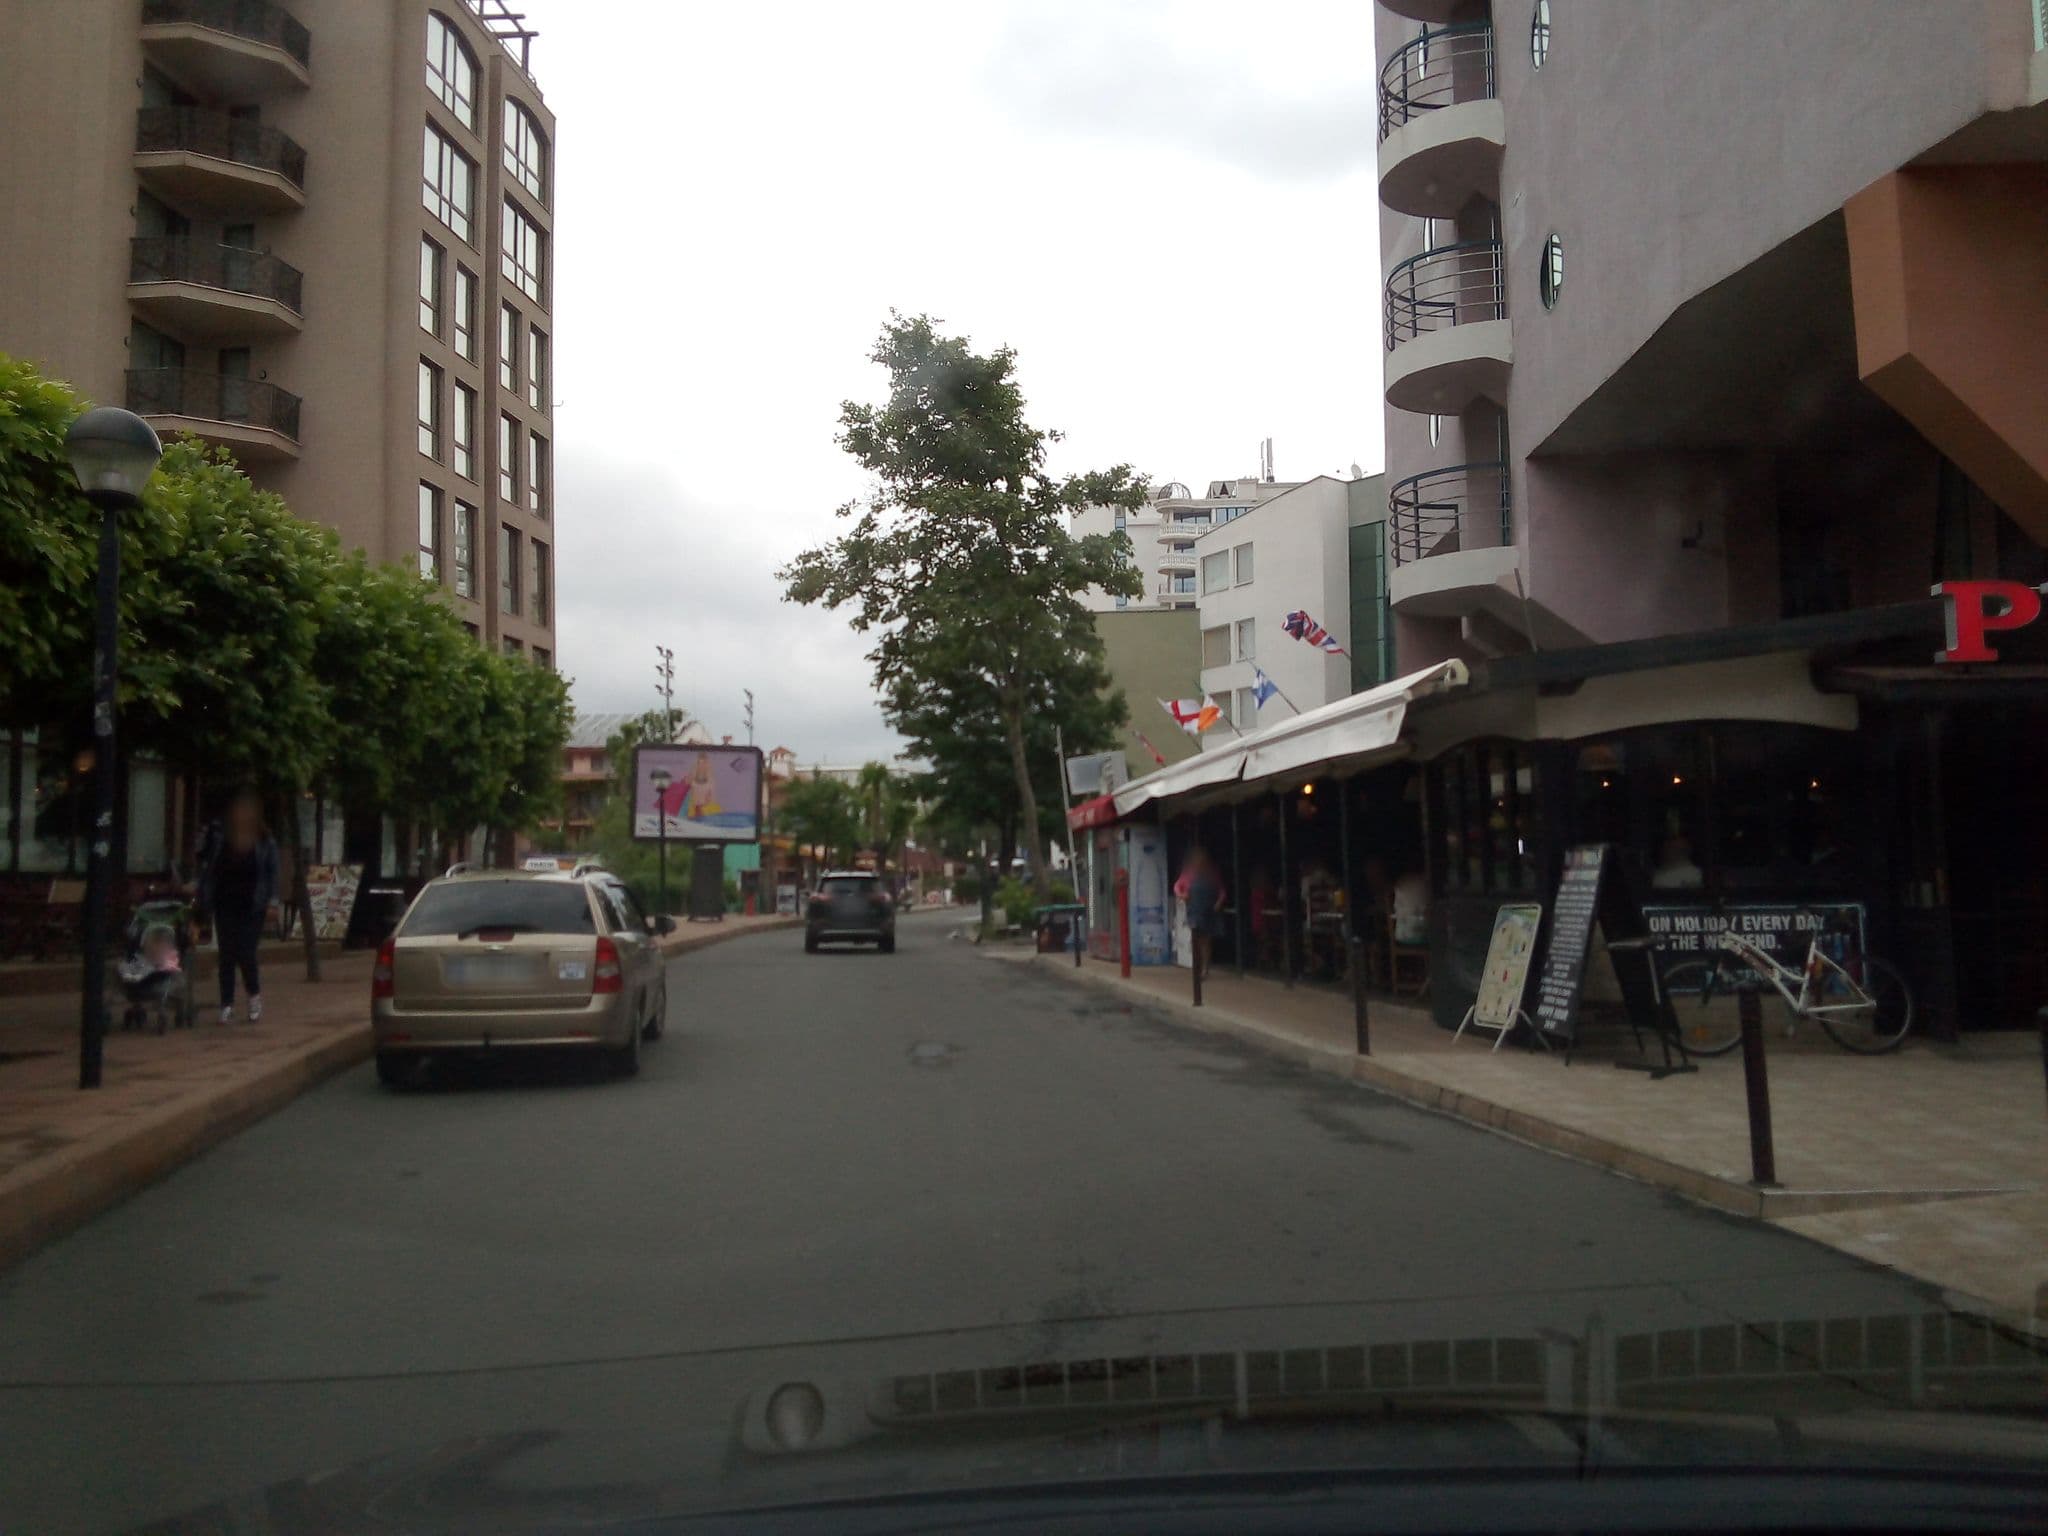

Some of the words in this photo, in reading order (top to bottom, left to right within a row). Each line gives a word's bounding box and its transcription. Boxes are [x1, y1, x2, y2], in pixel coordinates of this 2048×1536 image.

[1649, 916, 1671, 933] ON
[1742, 914, 1791, 931] EVERY
[1795, 913, 1825, 931] DAY
[1669, 934, 1700, 951] THE
